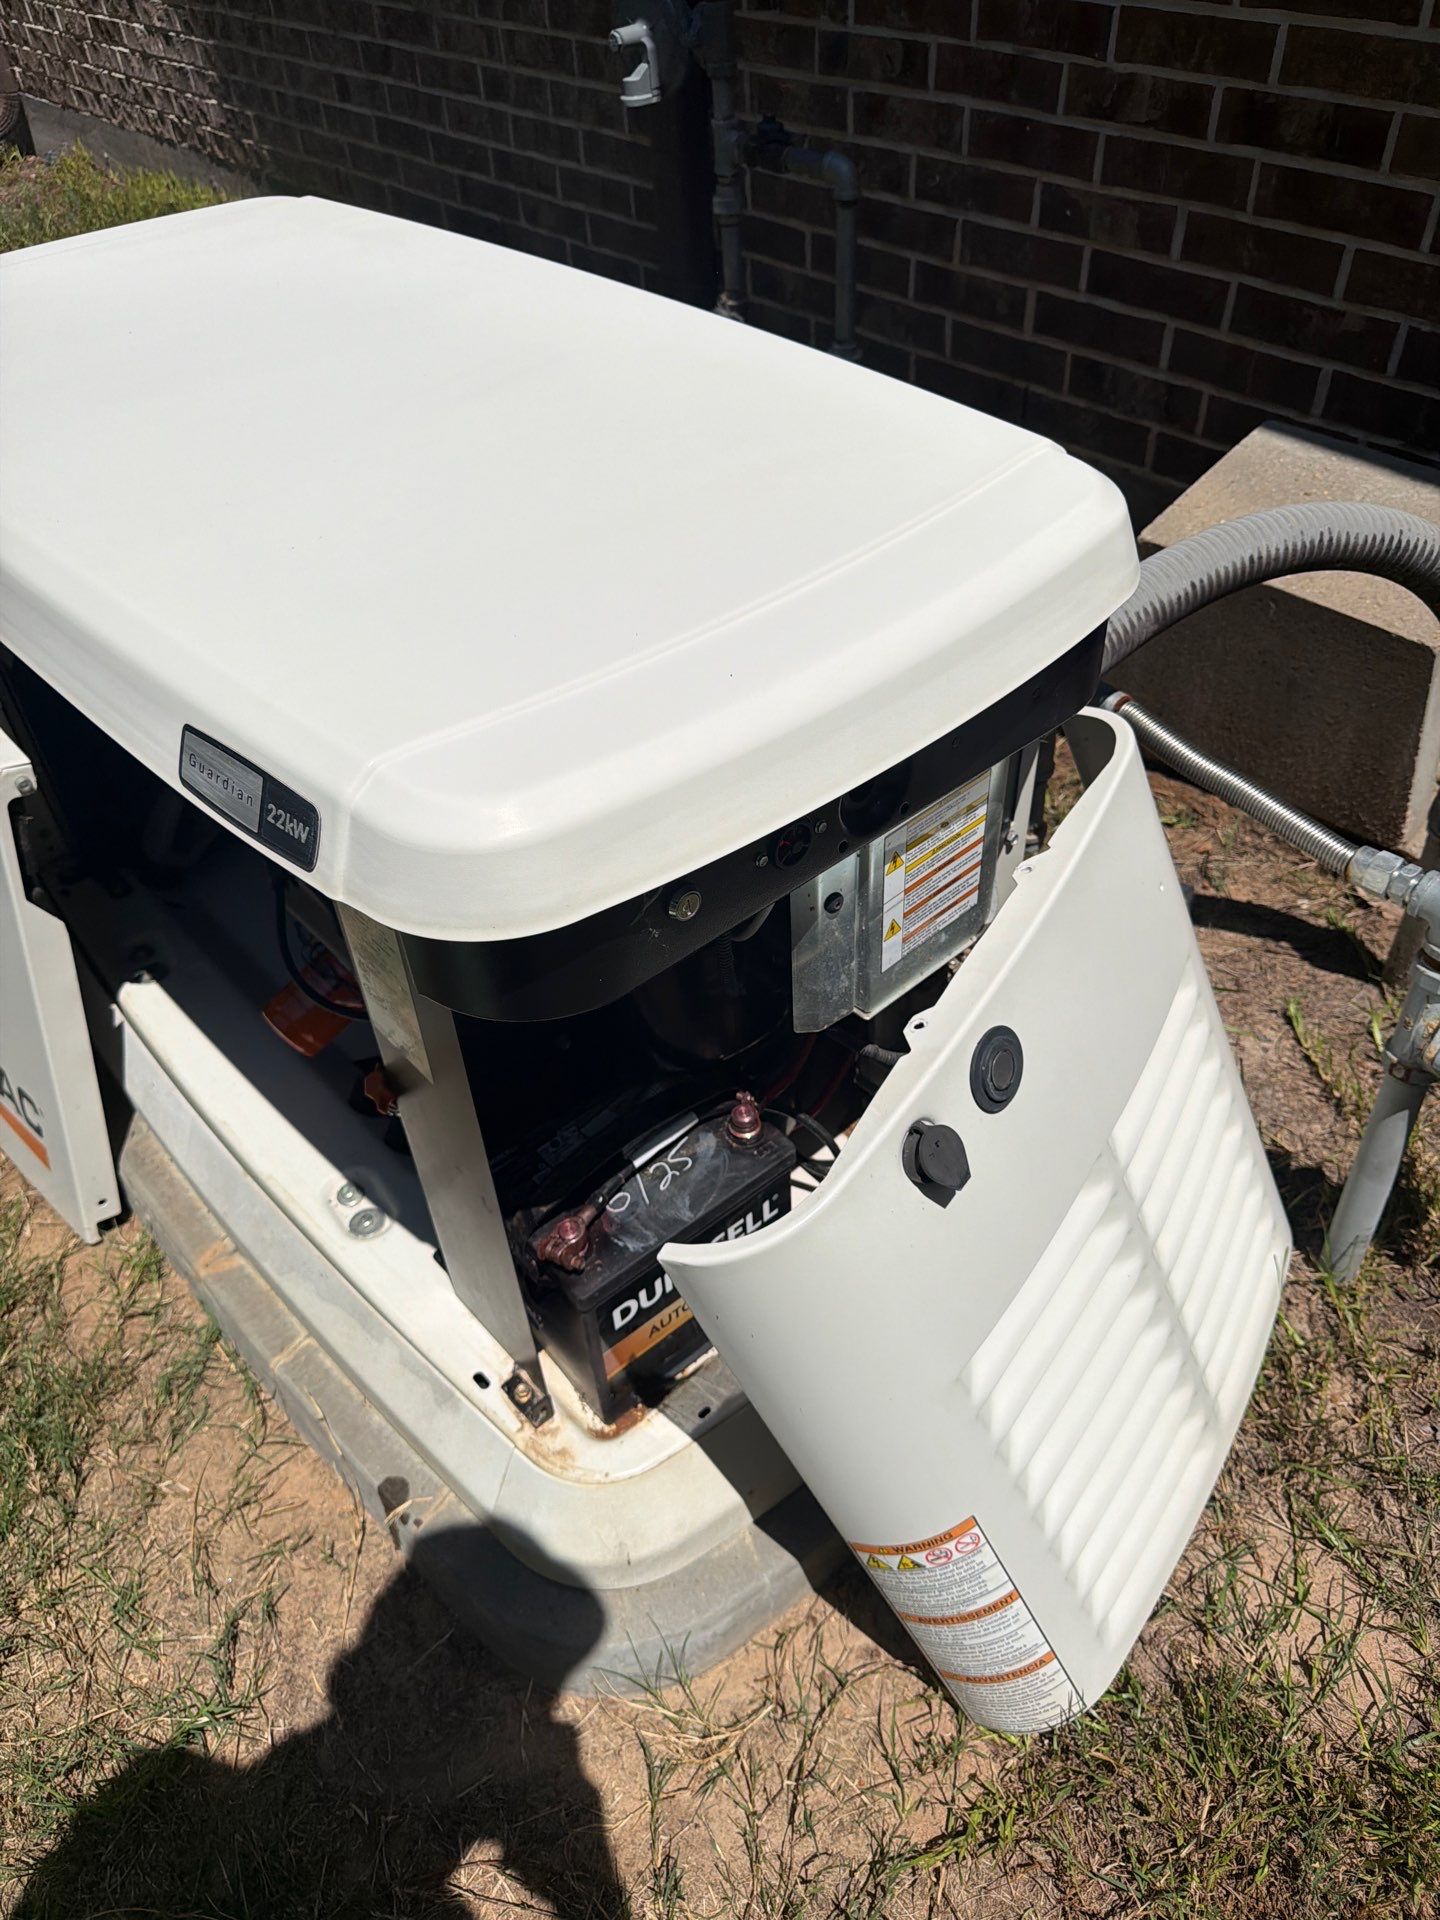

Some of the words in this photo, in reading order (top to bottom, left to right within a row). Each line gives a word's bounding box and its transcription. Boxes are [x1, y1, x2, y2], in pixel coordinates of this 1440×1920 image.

[188, 752, 254, 808] Guardian
[266, 803, 310, 844] 22kW
[892, 1532, 953, 1554] WARNING
[965, 1659, 1046, 1682] ADVERTENCIA
